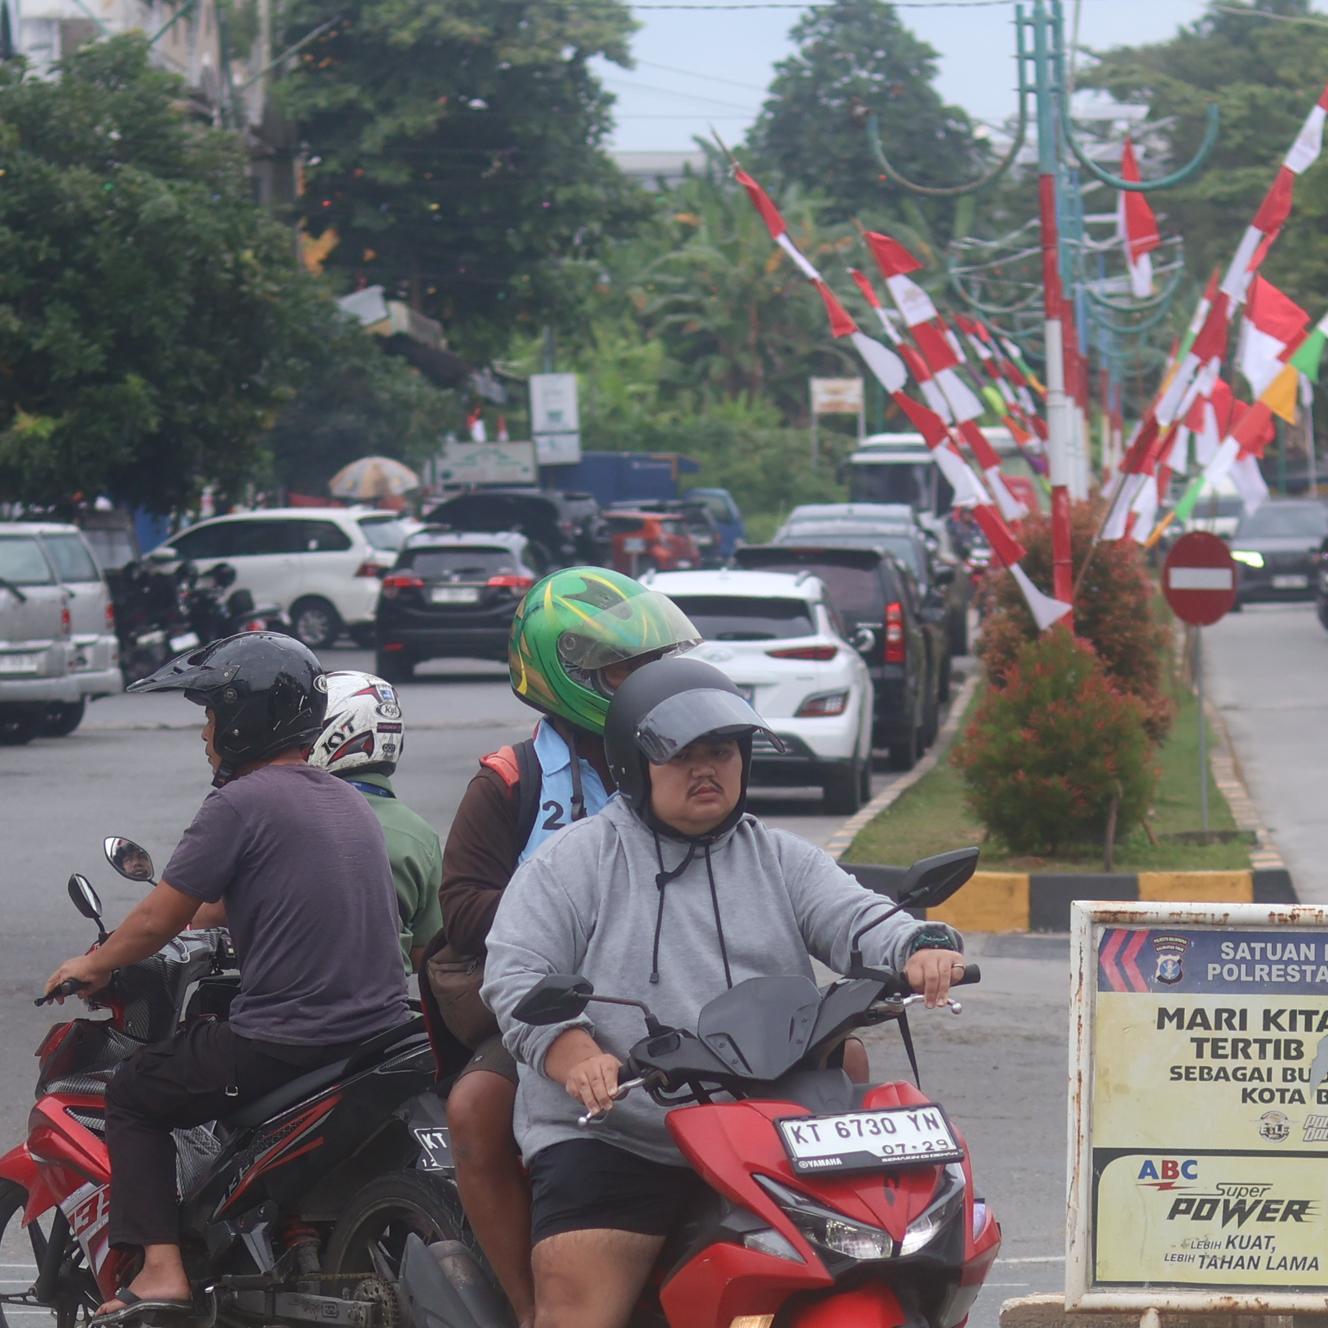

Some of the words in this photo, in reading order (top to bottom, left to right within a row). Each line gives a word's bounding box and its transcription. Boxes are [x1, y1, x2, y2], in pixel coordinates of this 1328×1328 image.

[1220, 942, 1316, 962] SATUAN
[1156, 1007, 1247, 1032] MARI
[1190, 1037, 1305, 1061] TERTIB
[1169, 1066, 1272, 1083] SEBAGAI
[1241, 1087, 1306, 1105] KOTA
[790, 1124, 821, 1145] KT
[835, 1117, 897, 1139] 6730
[907, 1112, 940, 1132] YN
[421, 1133, 447, 1149] KT
[806, 1157, 843, 1168] YAMAHA
[1138, 1159, 1198, 1180] ABC
[1215, 1183, 1274, 1199] Super
[1167, 1199, 1317, 1229] POWER
[1191, 1241, 1222, 1250] LEBIH
[1225, 1235, 1276, 1253] KUAT,
[1164, 1253, 1196, 1263] LEBIH
[1199, 1255, 1261, 1270] TAHAN
[1265, 1256, 1320, 1271] LAMA
